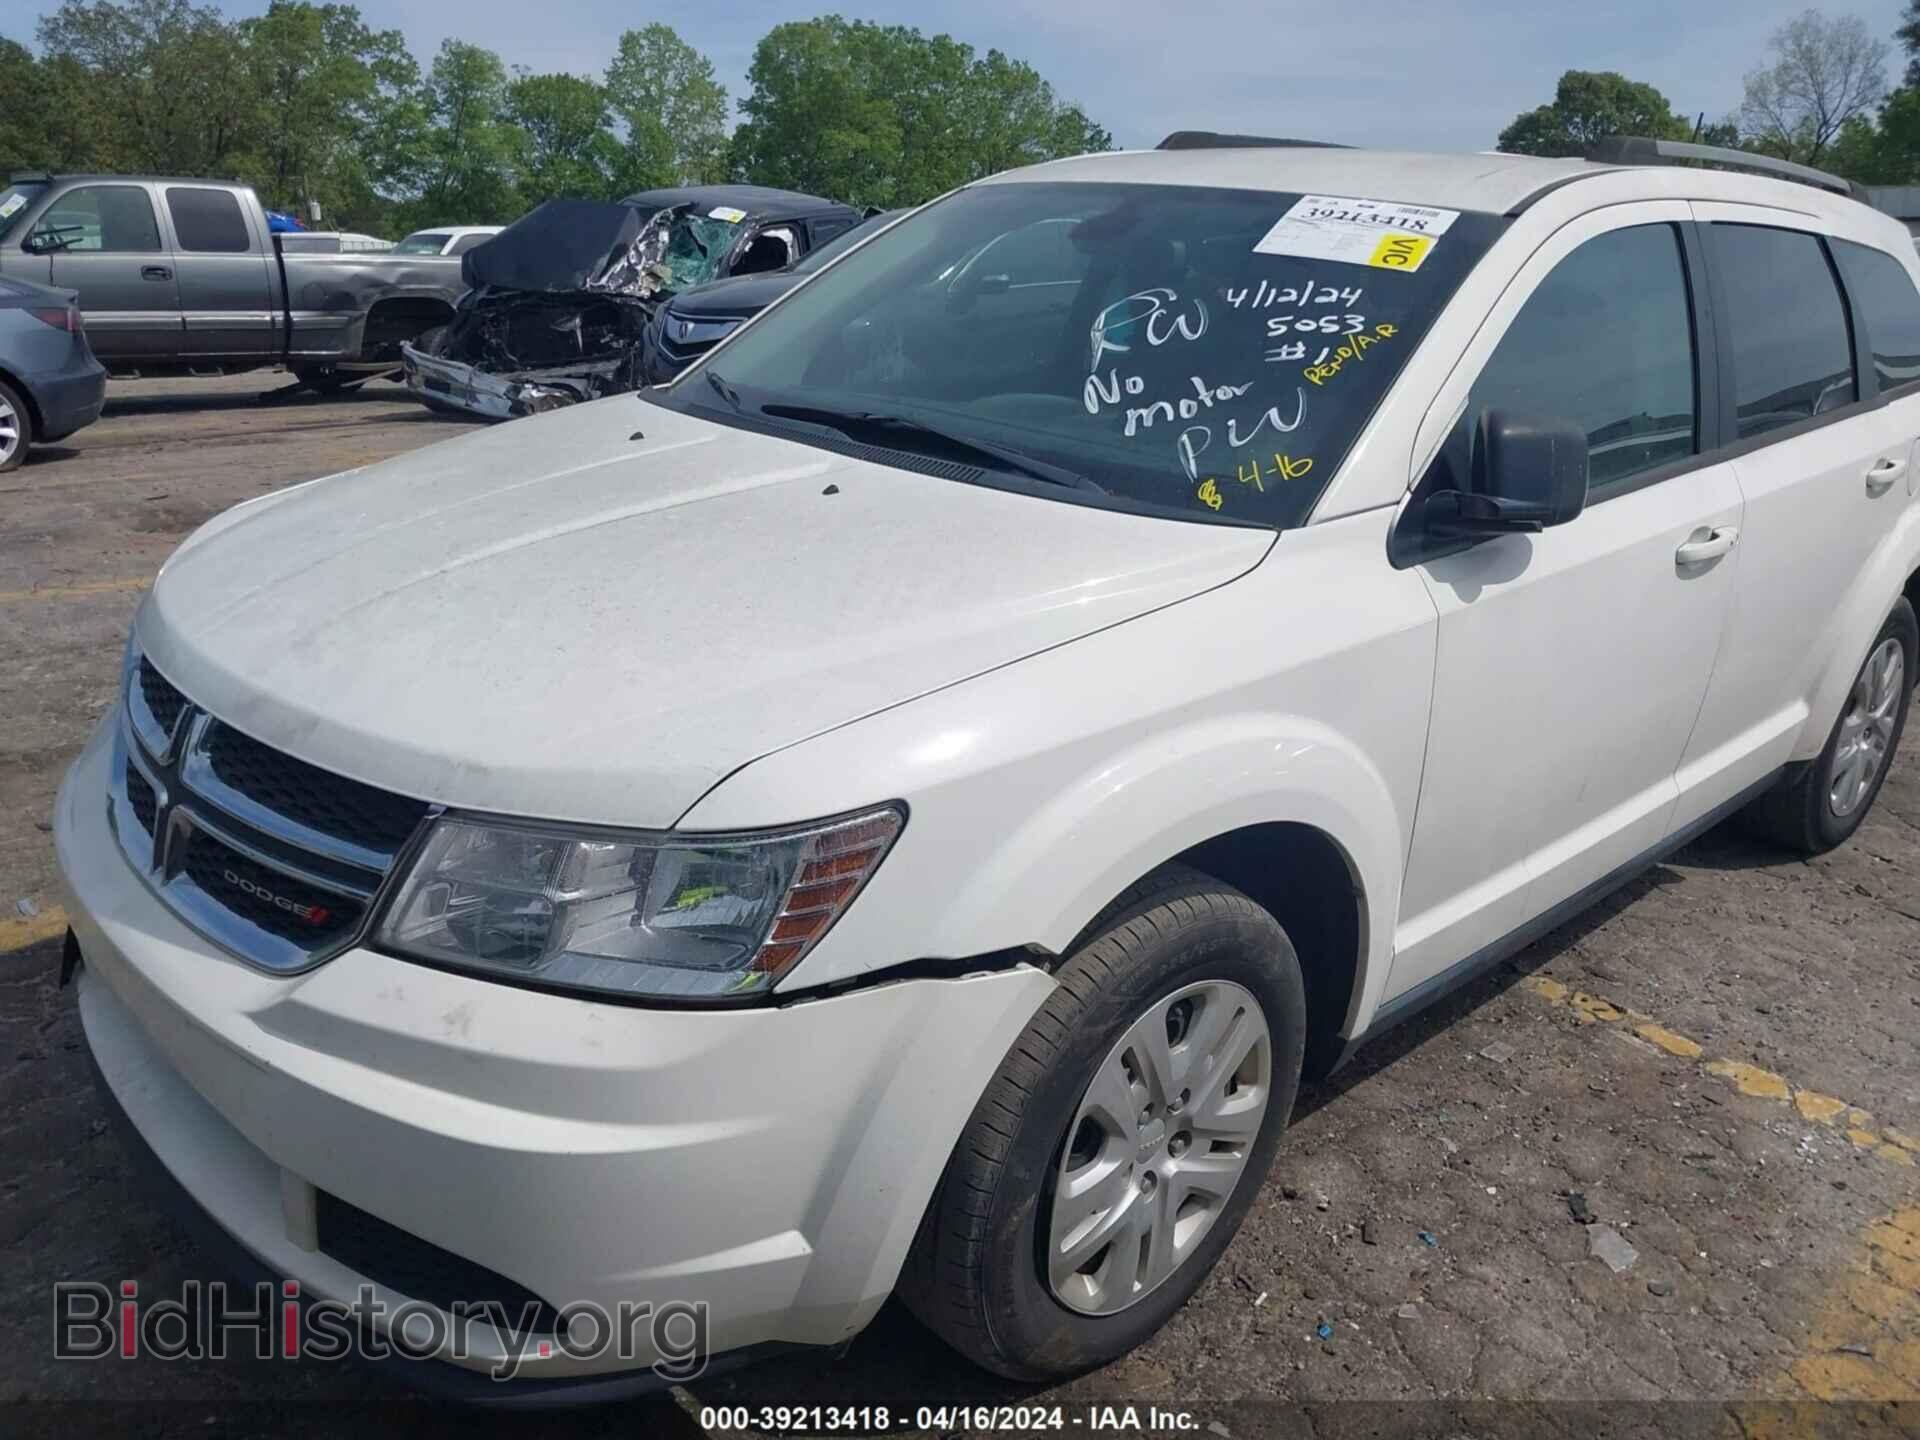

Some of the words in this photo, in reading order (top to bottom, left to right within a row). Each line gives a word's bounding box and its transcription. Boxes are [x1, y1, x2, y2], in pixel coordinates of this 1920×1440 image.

[1382, 238, 1419, 266] VIC
[1226, 279, 1363, 309] 4/12/24
[1239, 453, 1313, 493] 4-16
[223, 869, 313, 919] DODGE
